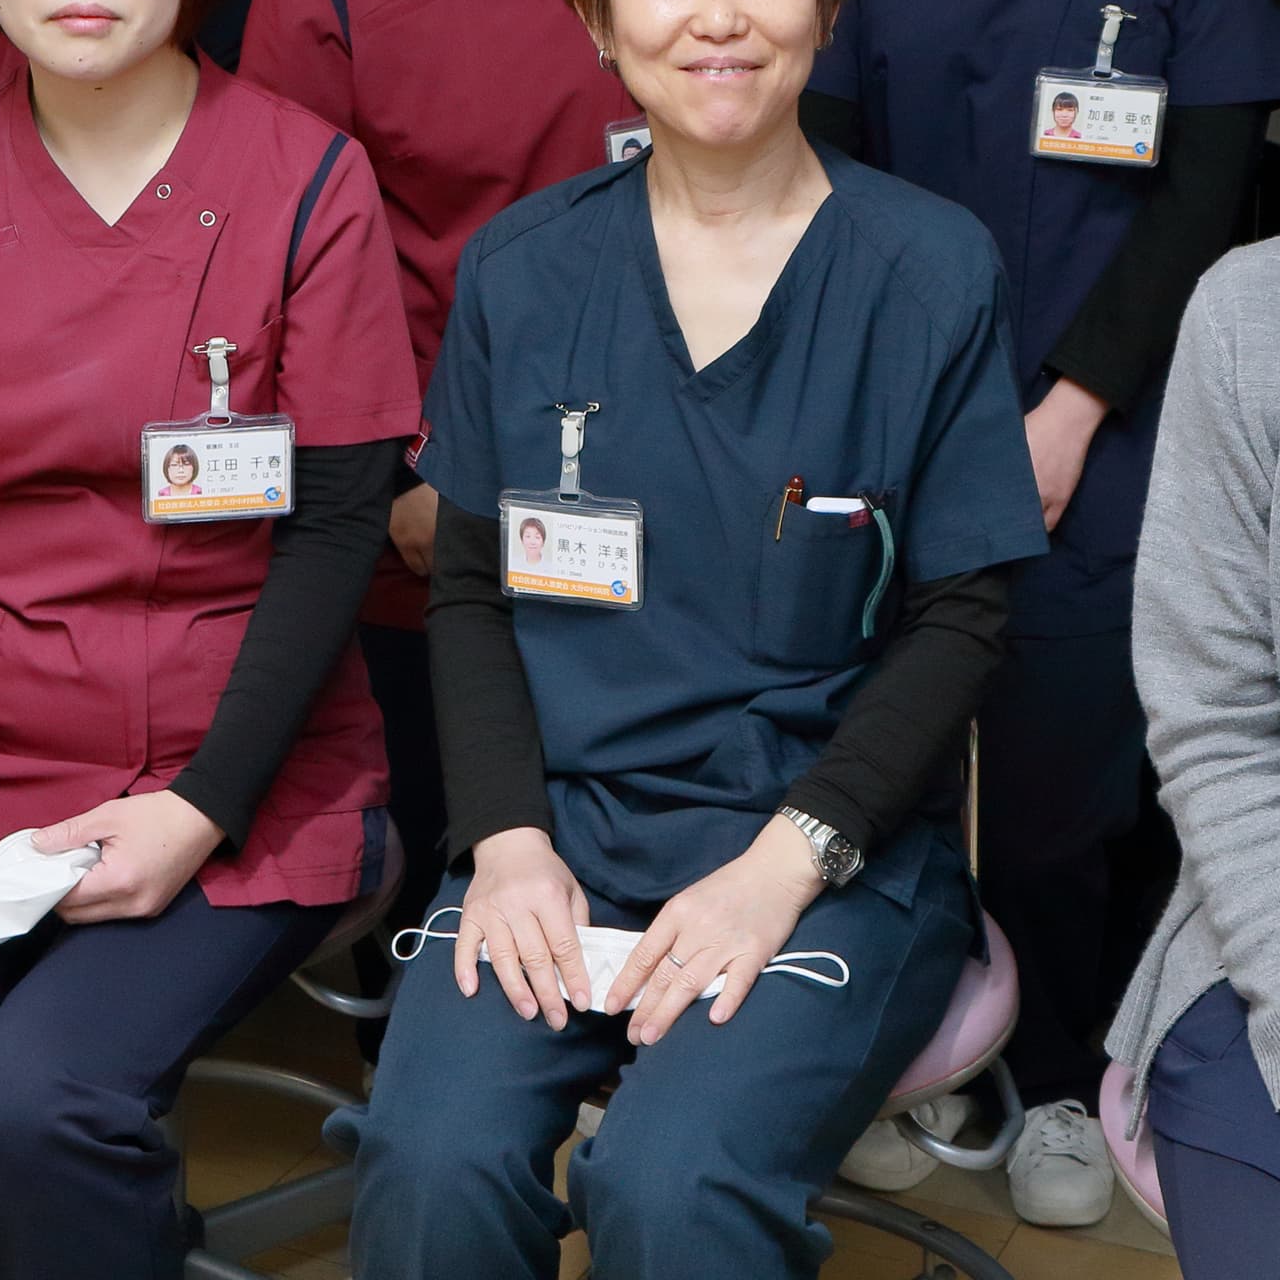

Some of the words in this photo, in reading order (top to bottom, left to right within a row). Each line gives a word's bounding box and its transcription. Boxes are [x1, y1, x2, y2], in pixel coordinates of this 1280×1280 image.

[206, 458, 239, 473] 江田
[250, 455, 282, 470] 千春
[557, 538, 588, 555] 黒木
[597, 544, 629, 562] 洋美
[597, 560, 629, 572] ひろみ
